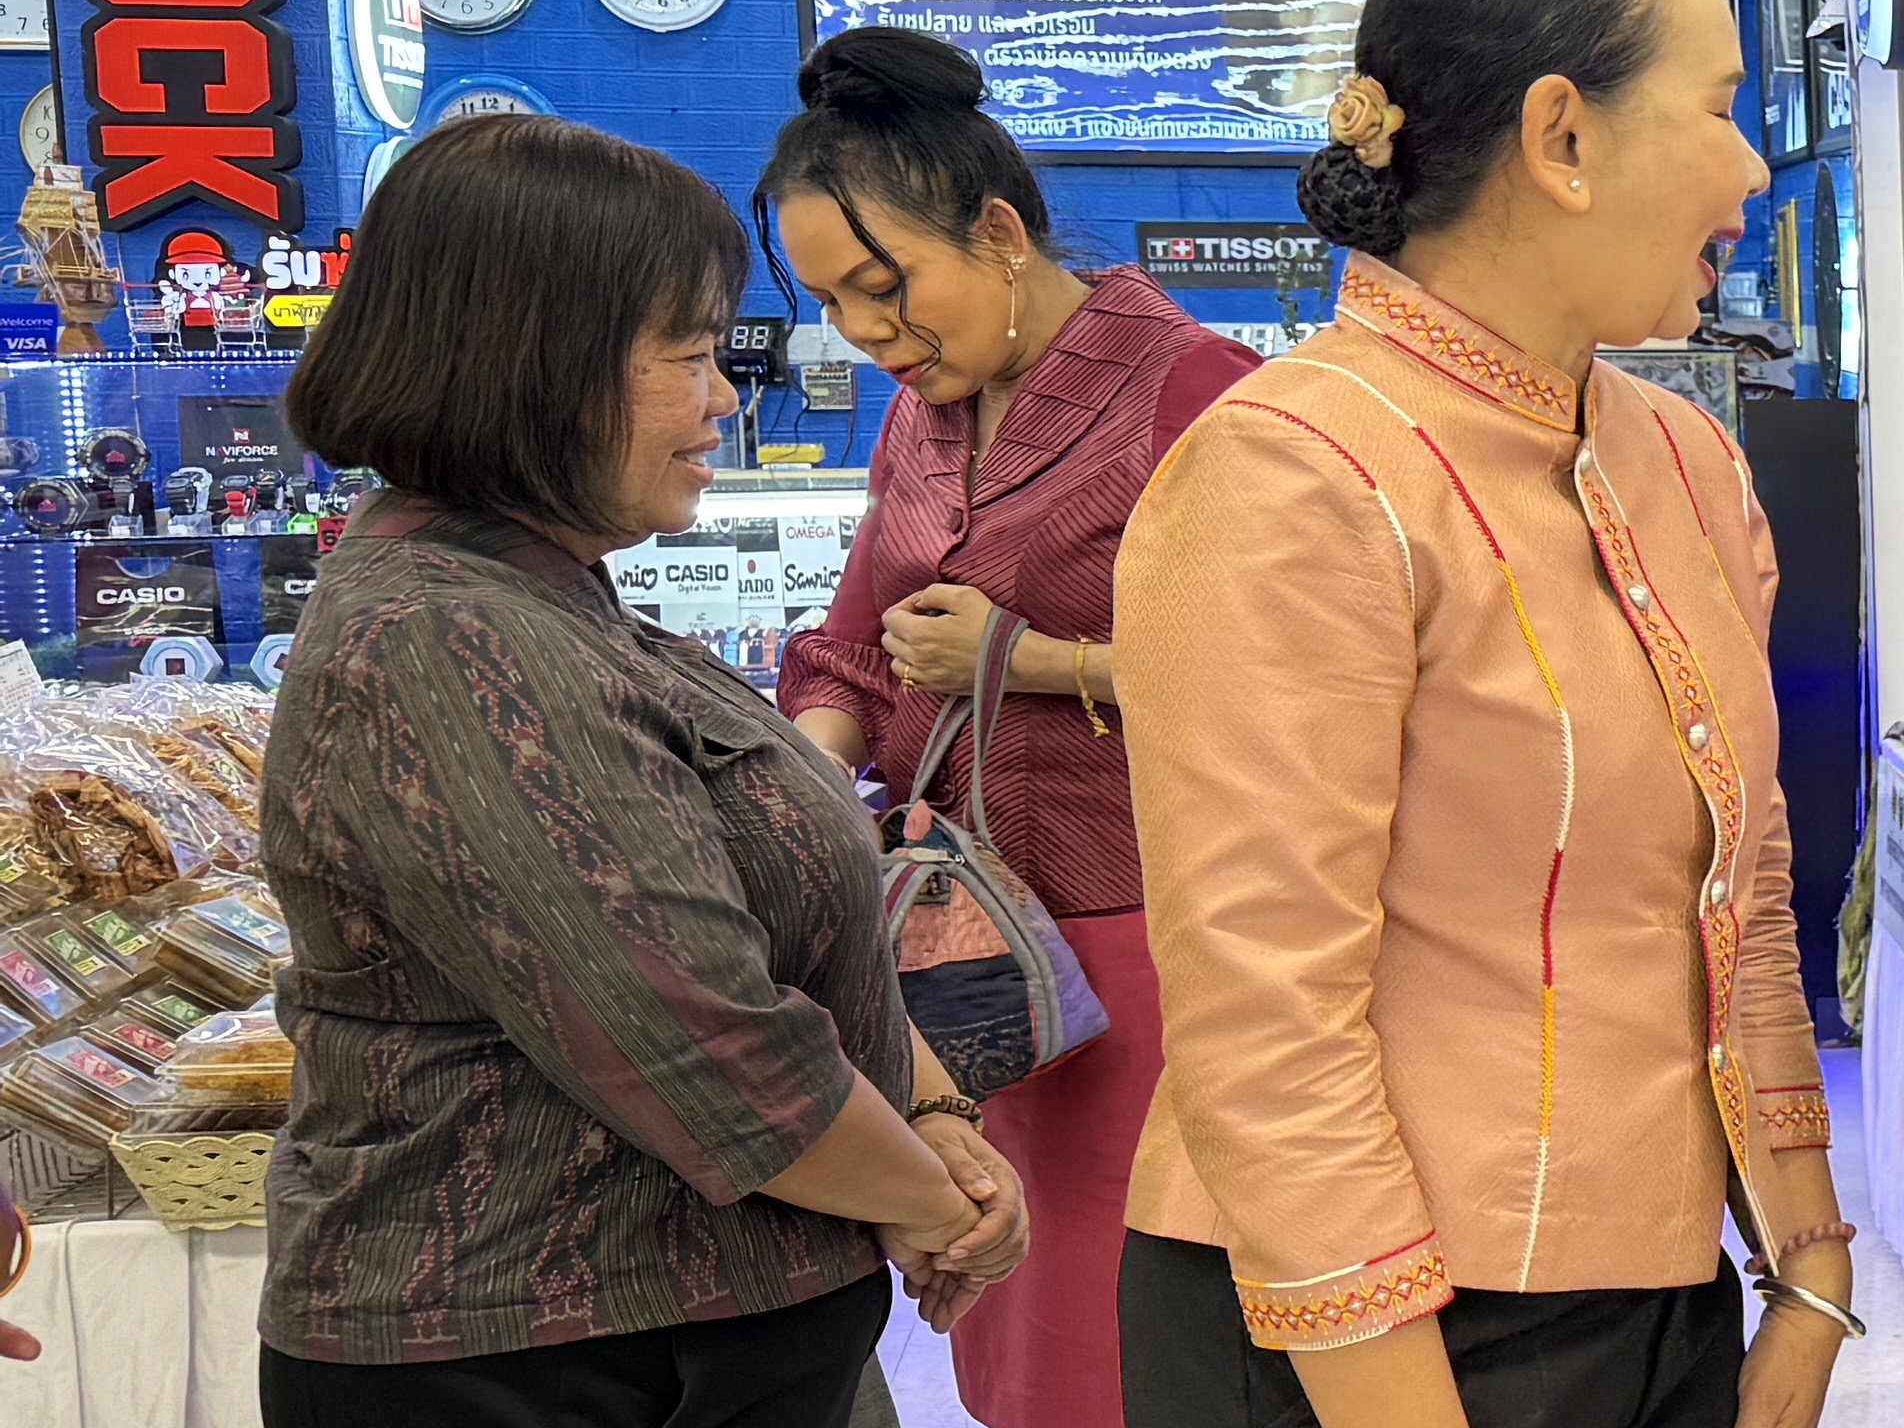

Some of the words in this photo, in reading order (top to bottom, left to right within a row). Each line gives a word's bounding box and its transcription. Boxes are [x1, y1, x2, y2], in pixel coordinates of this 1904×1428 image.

[461, 0, 473, 15] 6
[1195, 237, 1321, 260] TISSOT
[3, 336, 48, 351] VISA
[785, 525, 836, 540] OMEGA
[664, 563, 729, 583] CASIO
[95, 585, 186, 605] CASIO
